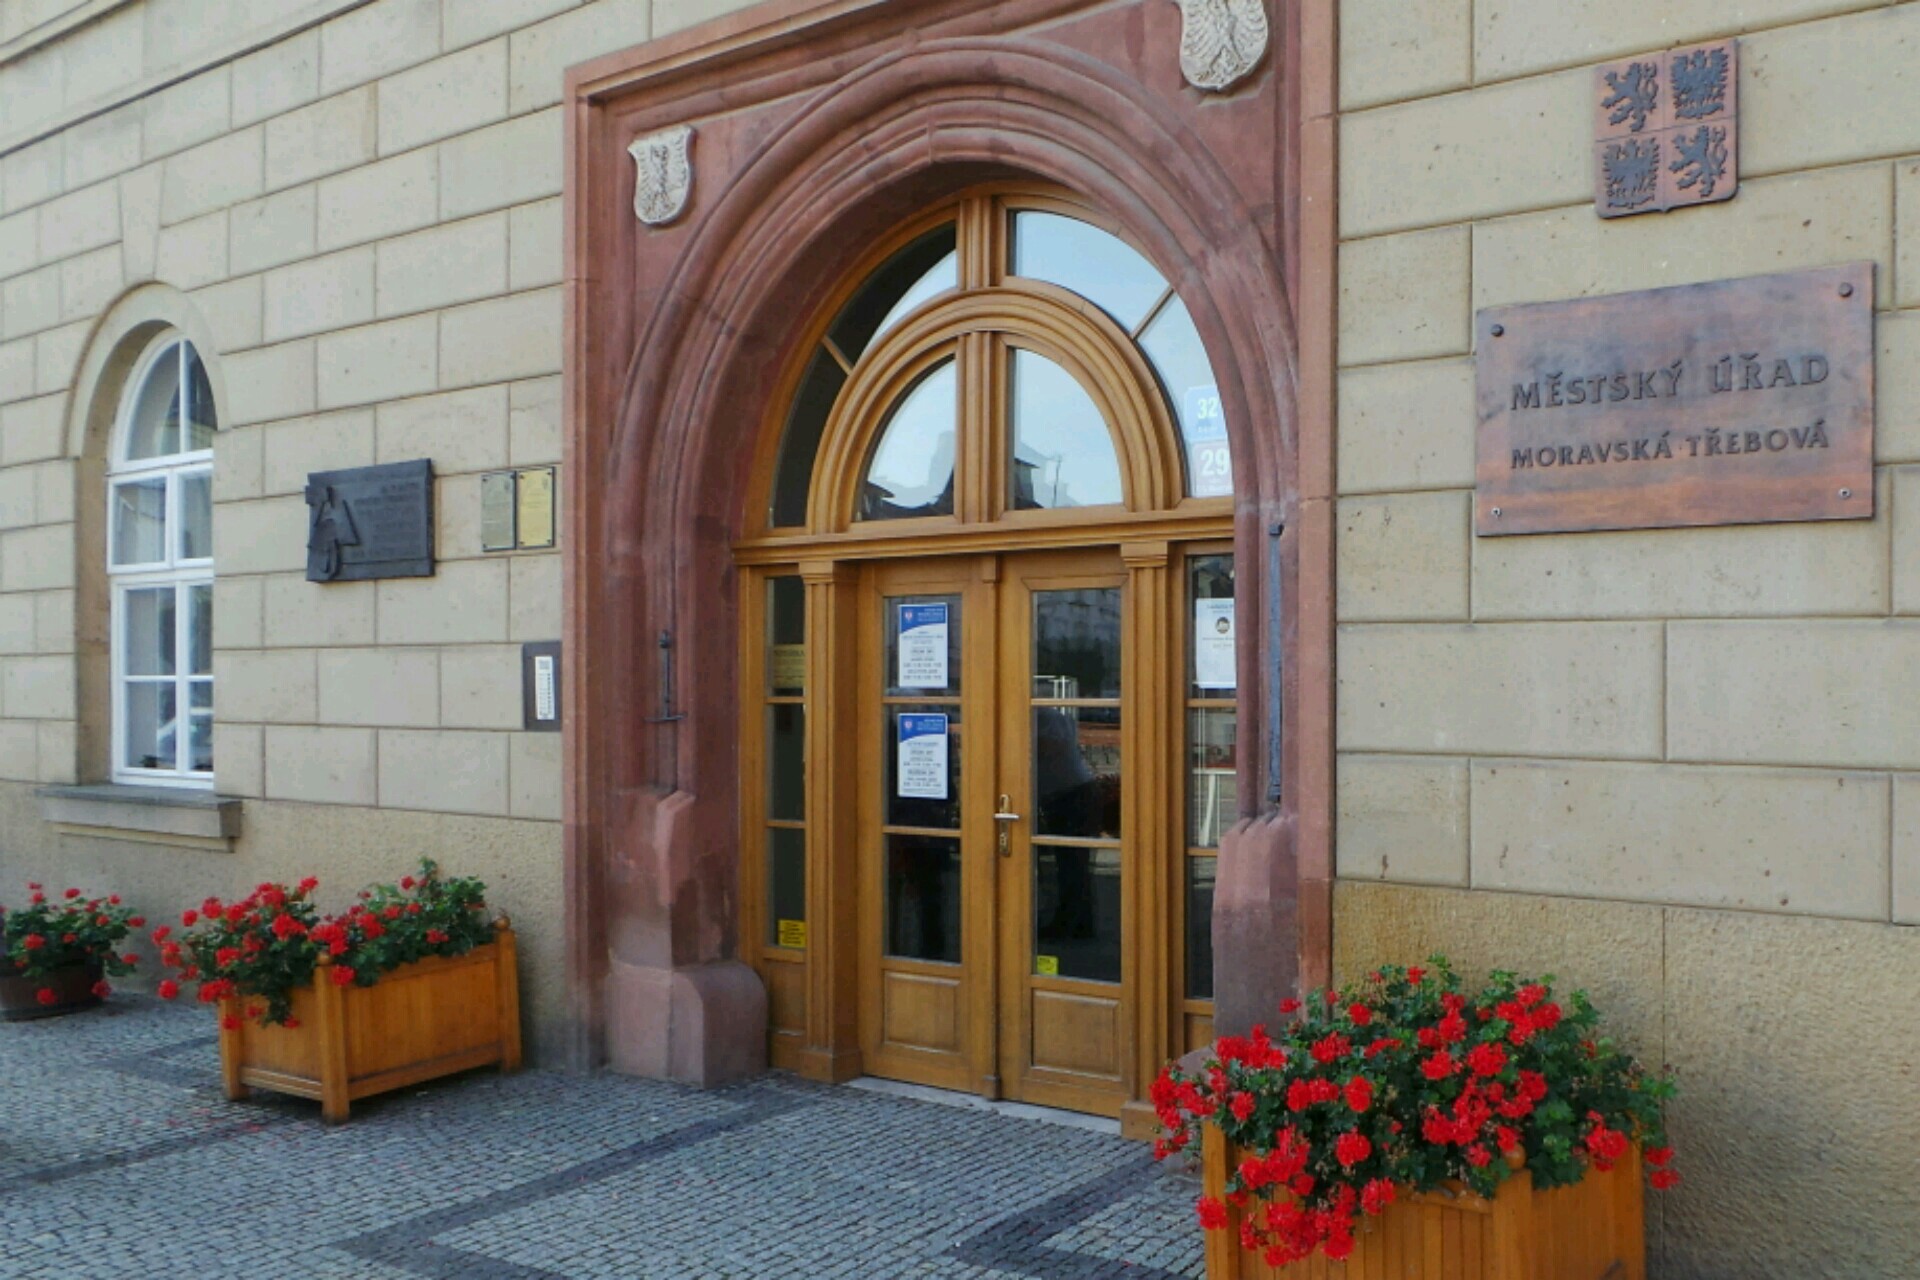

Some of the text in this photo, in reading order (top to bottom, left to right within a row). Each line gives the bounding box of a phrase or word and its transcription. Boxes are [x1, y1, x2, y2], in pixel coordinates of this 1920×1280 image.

[1511, 351, 1829, 410] MĚSTSKÝ ÚŘAD
[1197, 397, 1219, 419] 32
[1201, 448, 1230, 476] 29
[1511, 419, 1829, 469] MORAVSKÁ TŘEBOVÁ
